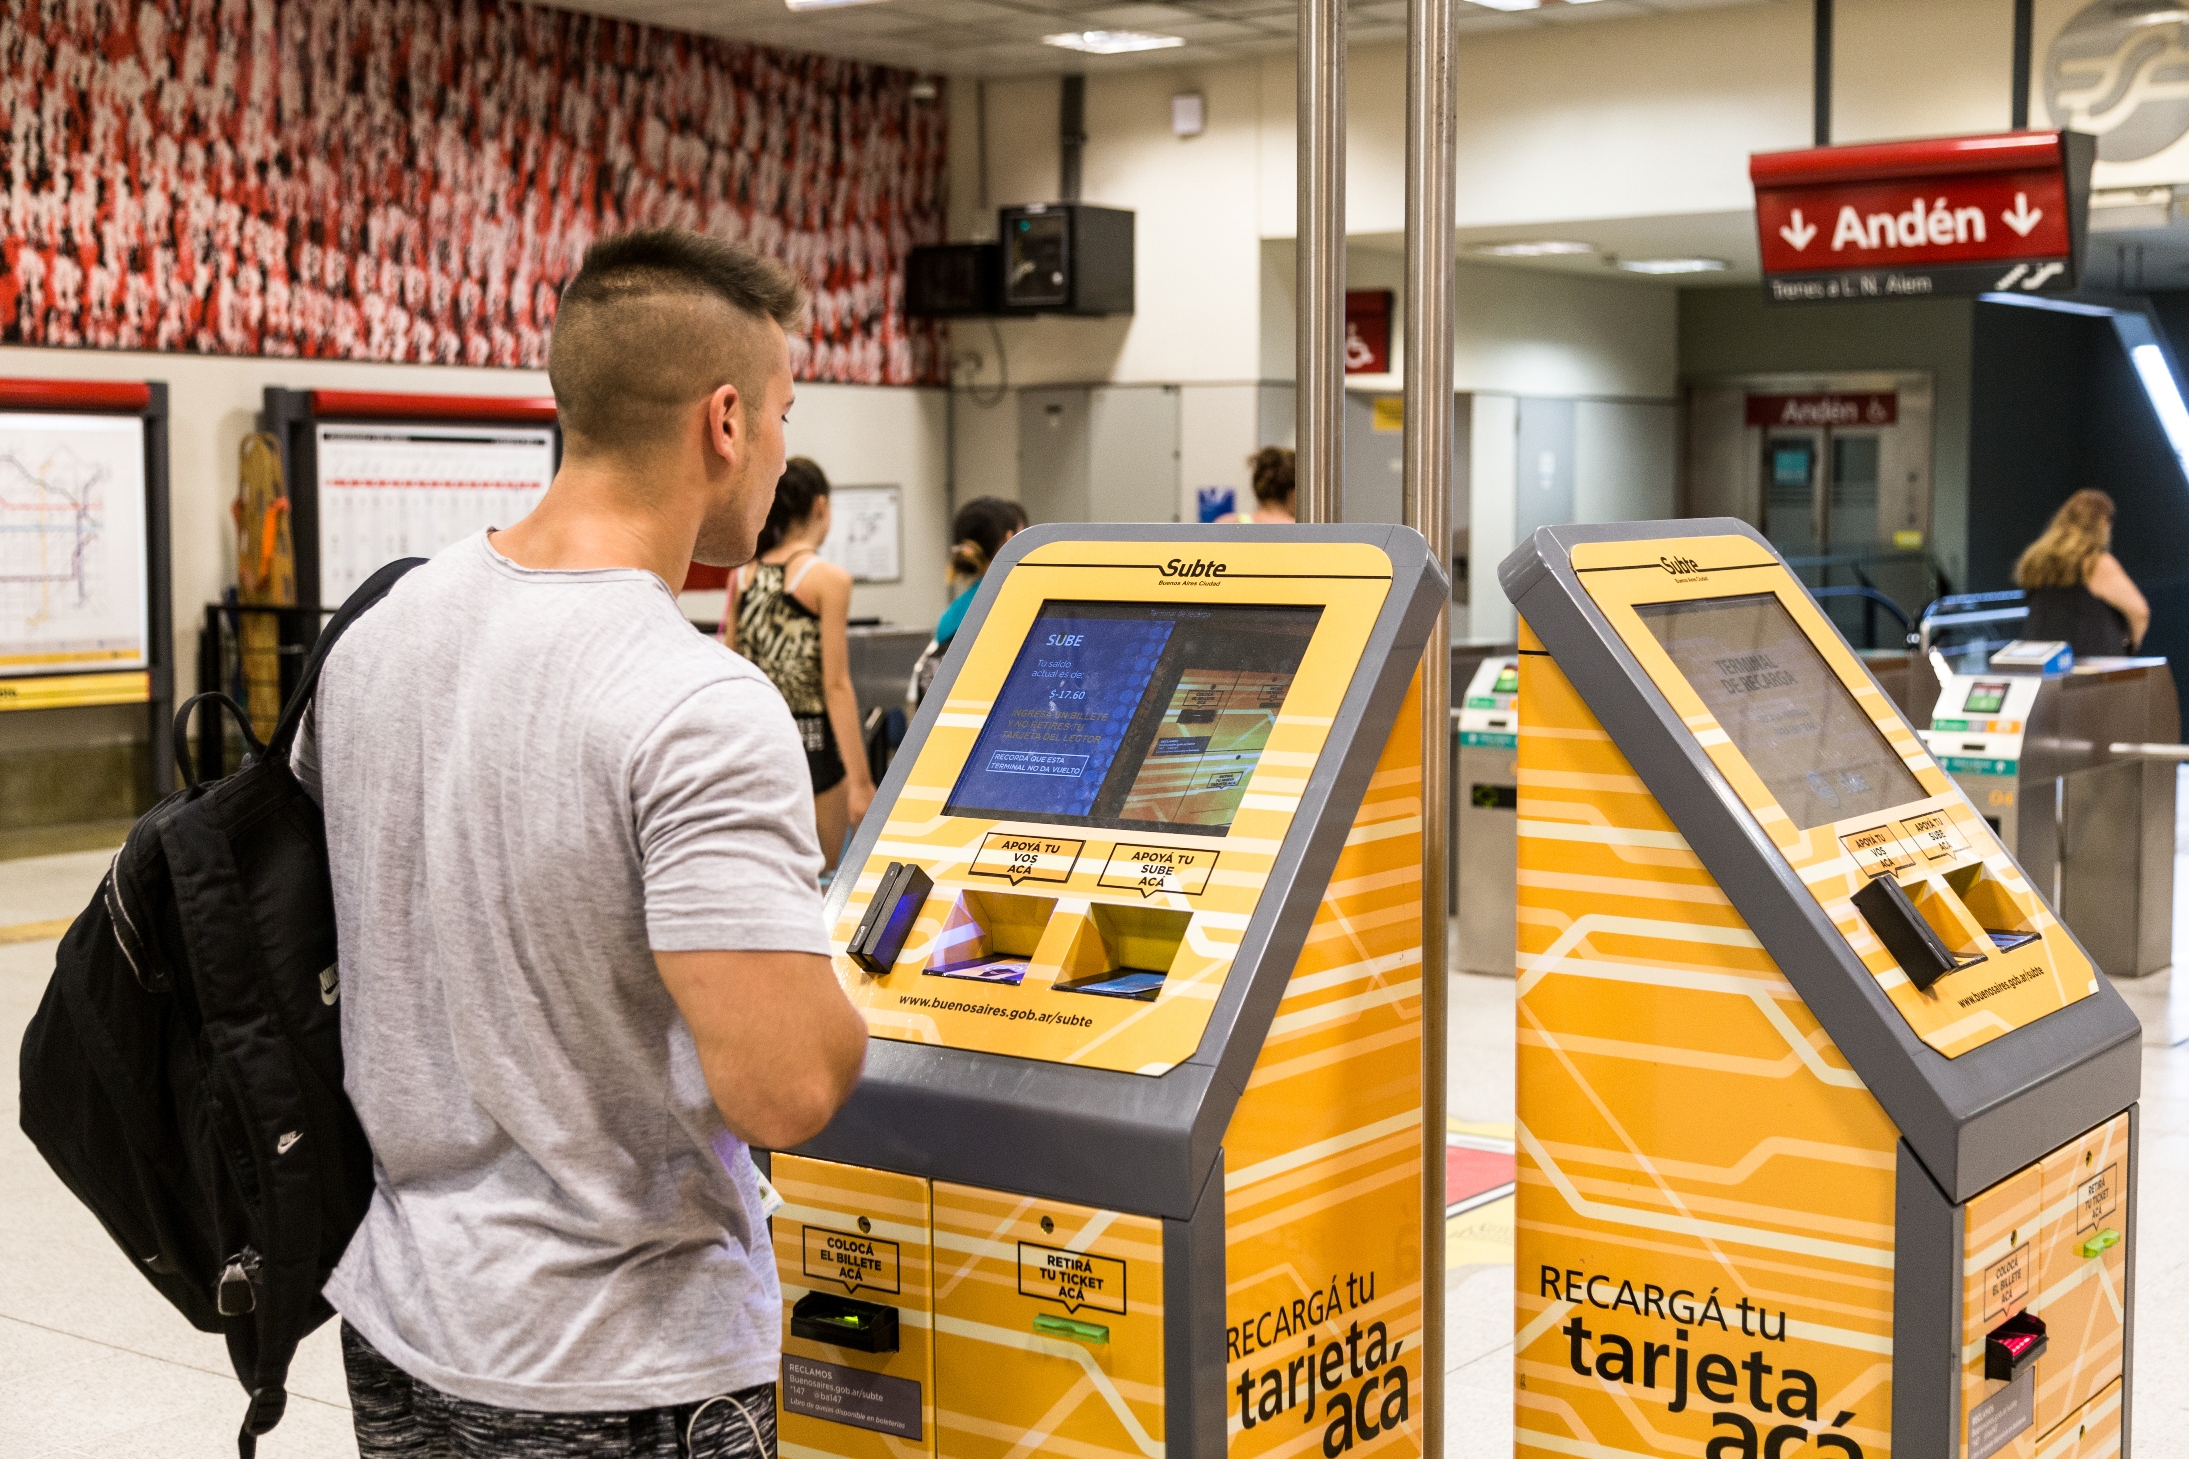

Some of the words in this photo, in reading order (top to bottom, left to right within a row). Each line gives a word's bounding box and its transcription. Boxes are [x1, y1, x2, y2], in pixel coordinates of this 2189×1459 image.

[1831, 197, 1986, 251] Andén
[1163, 558, 1227, 578] Subte
[1660, 556, 1698, 574] Subte
[1046, 634, 1084, 647] SUBE
[1038, 660, 1048, 668] Tu
[1048, 660, 1072, 669] saldo
[1714, 654, 1778, 676] TERMINAL
[1032, 669, 1057, 678] actual
[1720, 678, 1742, 694] DE
[1049, 690, 1086, 700] $-17.60
[1012, 709, 1050, 719] INGRESA
[1055, 711, 1068, 719] UN
[1070, 712, 1109, 722] BILLETE
[1031, 722, 1070, 730] RETIRES
[1071, 724, 1084, 732] TU
[1002, 731, 1042, 740] TARJETA
[1043, 733, 1060, 742] DEL
[1064, 734, 1102, 744] LECTOR
[991, 762, 1026, 771] TERMINAL
[1030, 756, 1046, 764] QUE
[1047, 756, 1064, 764] ESTA
[1914, 818, 1936, 832] APOYÁ
[1934, 818, 1944, 826] TU
[1856, 834, 1876, 848] APOYÁ
[1875, 834, 1886, 842] TU
[1928, 830, 1946, 841] SUBE
[1002, 840, 1041, 852] APOYÁ
[1045, 844, 1060, 854] TU
[1870, 847, 1886, 857] VOS
[1014, 853, 1038, 863] VOS
[1132, 852, 1174, 864] APOYÁ
[1178, 855, 1194, 865] TU
[1007, 863, 1032, 874] ACÁ
[1141, 864, 1174, 876] SUBE
[1138, 876, 1165, 888] ACÁ
[1958, 966, 2044, 1008] www.buenosaires.gob.ar/subte
[900, 994, 1092, 1028] www.buenosaires.gob.ar/subte
[2085, 1201, 2092, 1210] TU
[827, 1237, 874, 1256] COLOCÁ
[820, 1250, 834, 1262] EL
[836, 1253, 882, 1271] BILLETE
[1048, 1254, 1092, 1274] RETIRÁ
[1996, 1255, 2018, 1280] COLOCÁ
[839, 1267, 862, 1281] ACÁ
[1040, 1268, 1056, 1280] TU
[1059, 1272, 1104, 1290] TICKET
[1992, 1285, 2000, 1296] EL
[2000, 1268, 2022, 1292] BILLETE
[1058, 1286, 1084, 1301] ACÁ
[1540, 1264, 1728, 1332] RECARGÁ
[1736, 1296, 1786, 1342] tu
[1226, 1275, 1342, 1364] RECARGÁ
[1346, 1271, 1374, 1308] tu
[790, 1364, 832, 1380] RECLAMOS
[1236, 1320, 1388, 1430] tarjeta
[1563, 1316, 1818, 1422] tarjeta
[790, 1375, 884, 1402] Buenosaires.gob.ar/subte
[814, 1391, 842, 1404] @ba147
[1323, 1340, 1408, 1459] acá
[790, 1398, 806, 1406] Libro
[816, 1403, 834, 1414] quejas
[836, 1406, 866, 1420] disponible
[866, 1414, 874, 1422] en
